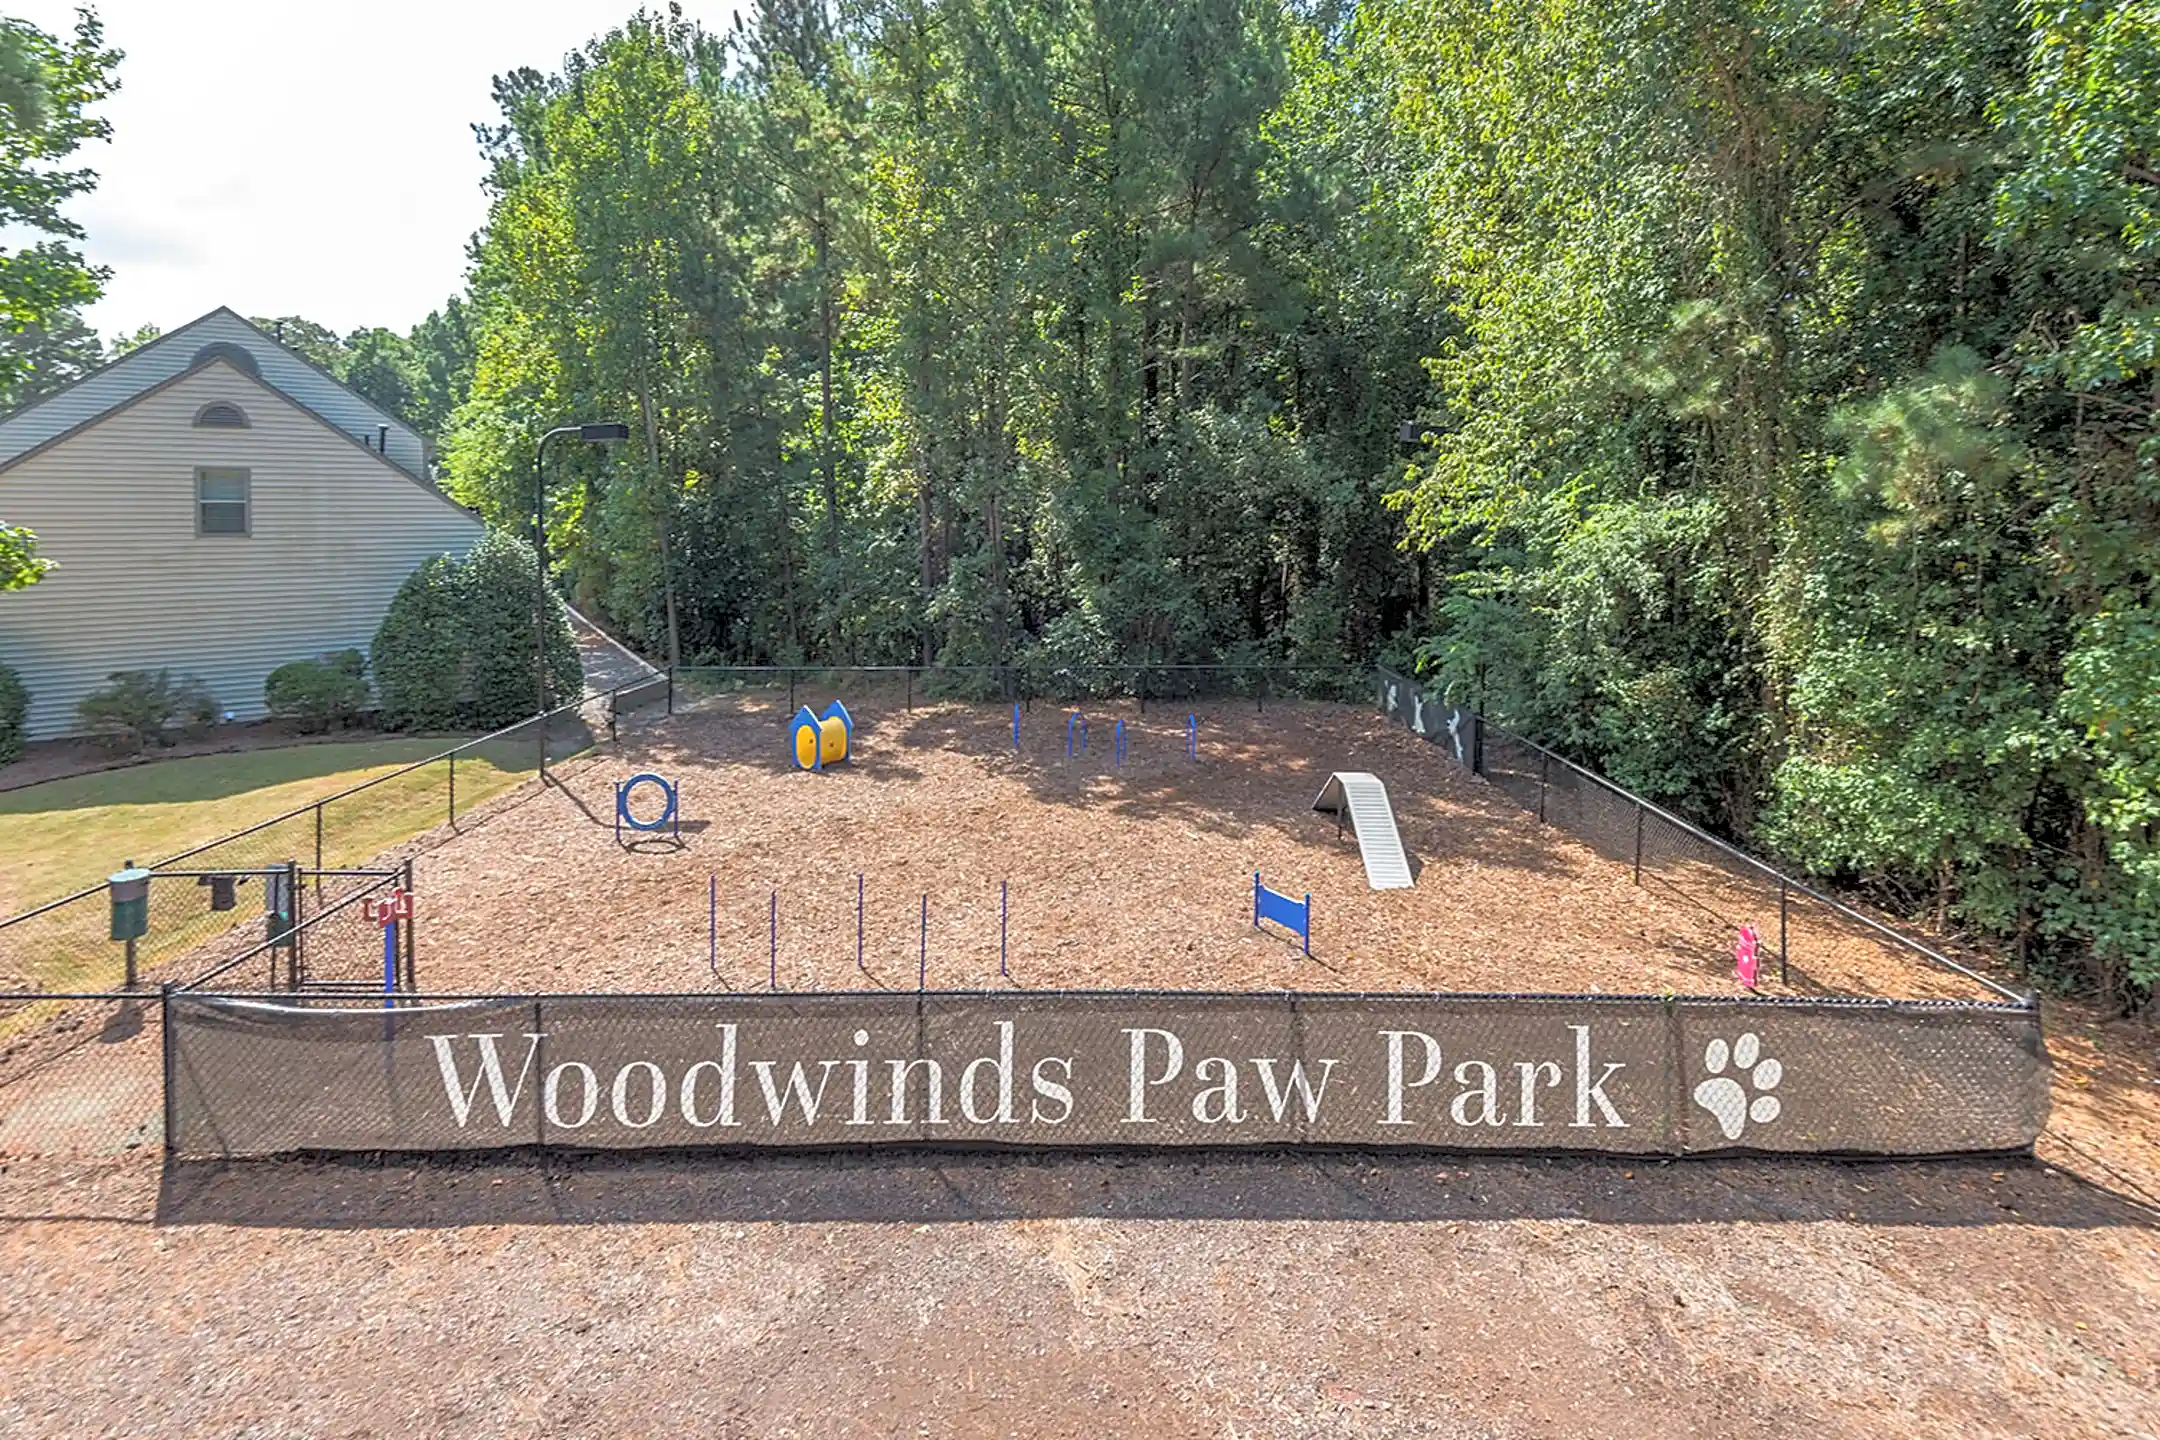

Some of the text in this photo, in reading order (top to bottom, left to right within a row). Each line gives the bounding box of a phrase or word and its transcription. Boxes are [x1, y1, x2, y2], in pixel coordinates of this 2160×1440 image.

[424, 1021, 1631, 1128] Woodwinds Paw Park
